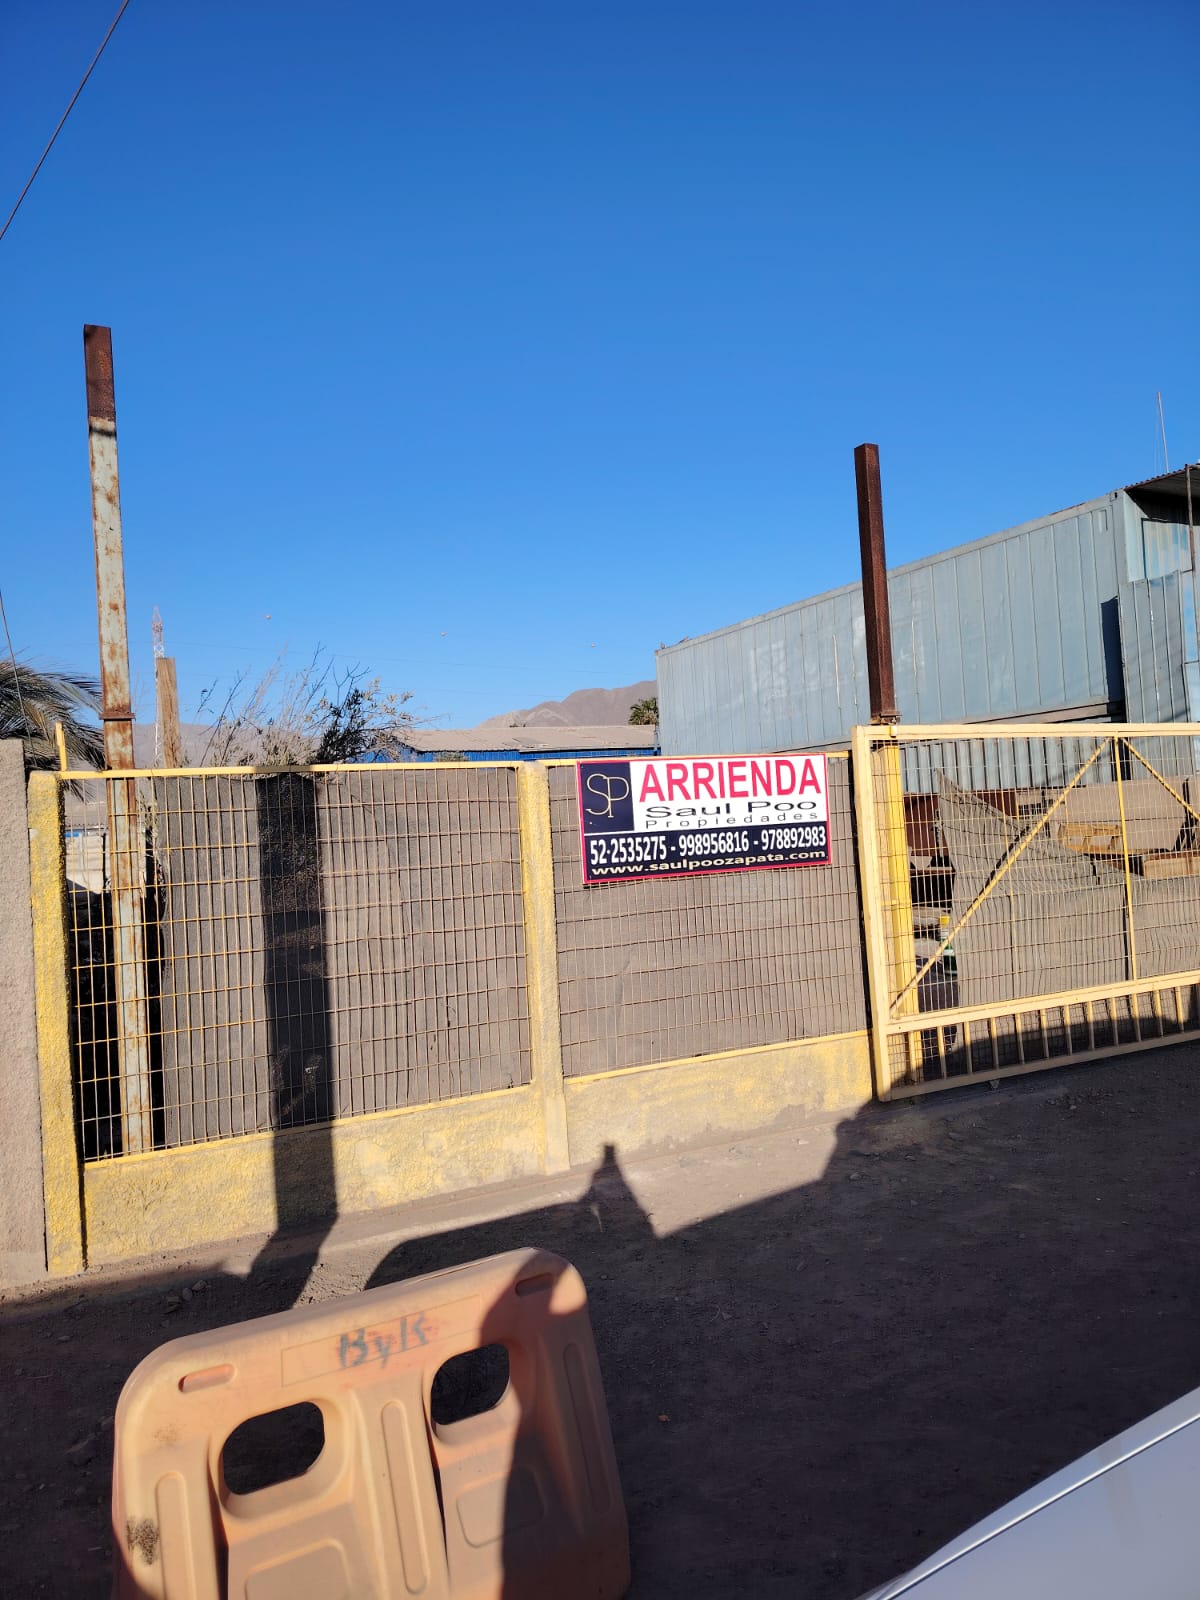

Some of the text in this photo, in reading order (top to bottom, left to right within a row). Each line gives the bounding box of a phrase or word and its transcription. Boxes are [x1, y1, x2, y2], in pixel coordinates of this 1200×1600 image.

[639, 758, 821, 803] ARRIENDA
[645, 801, 817, 818] Saul Poo
[645, 812, 818, 829] Propiedades
[678, 831, 749, 857] 998956816
[761, 826, 826, 850] 978892983
[591, 850, 826, 875] www.saulpoozapata.com
